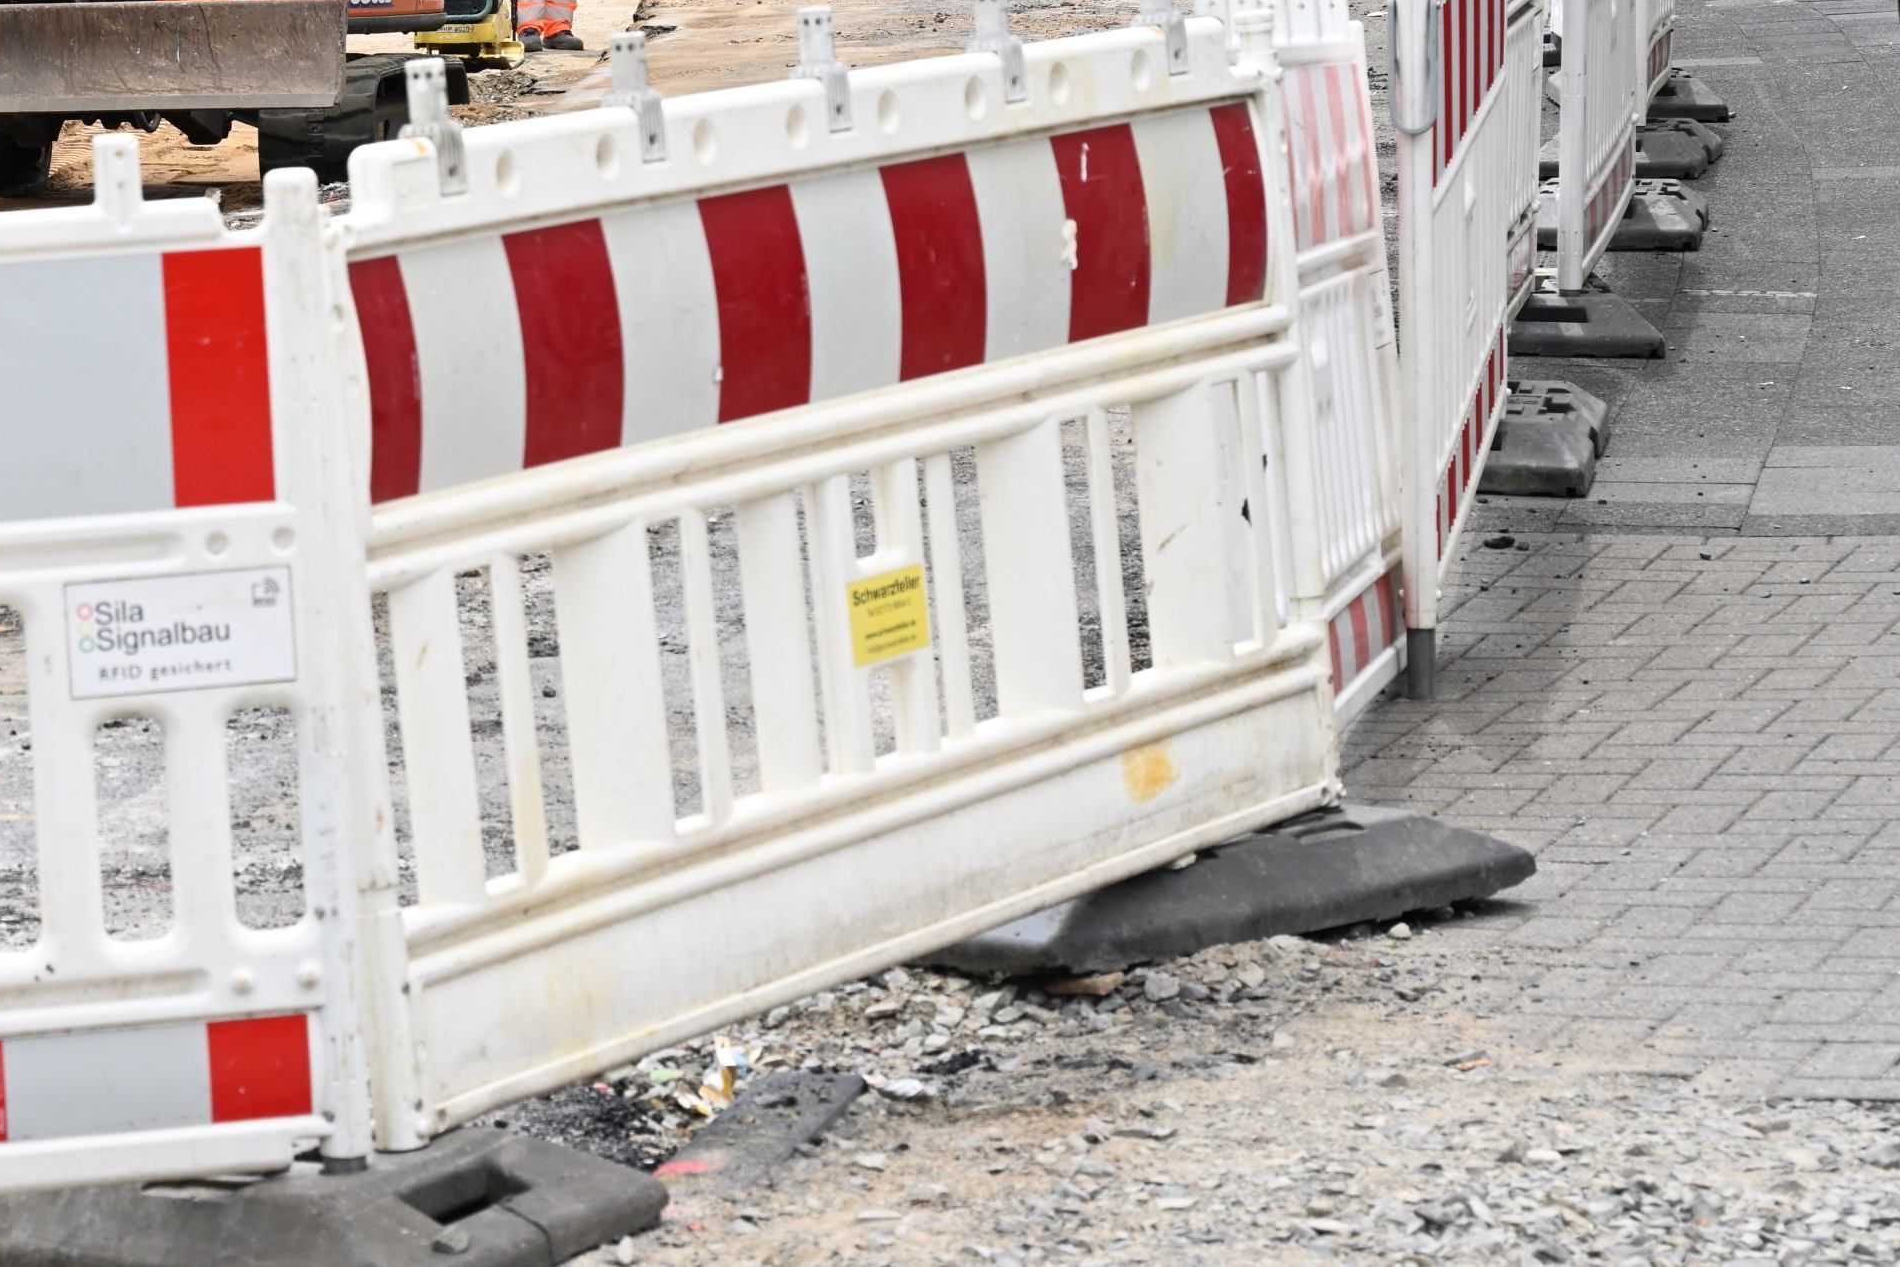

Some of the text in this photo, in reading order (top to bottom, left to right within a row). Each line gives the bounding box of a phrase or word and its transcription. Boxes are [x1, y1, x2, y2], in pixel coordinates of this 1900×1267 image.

[93, 600, 144, 627] Sila
[96, 621, 231, 655] Signalbau
[98, 658, 233, 682] RFID gesichert
